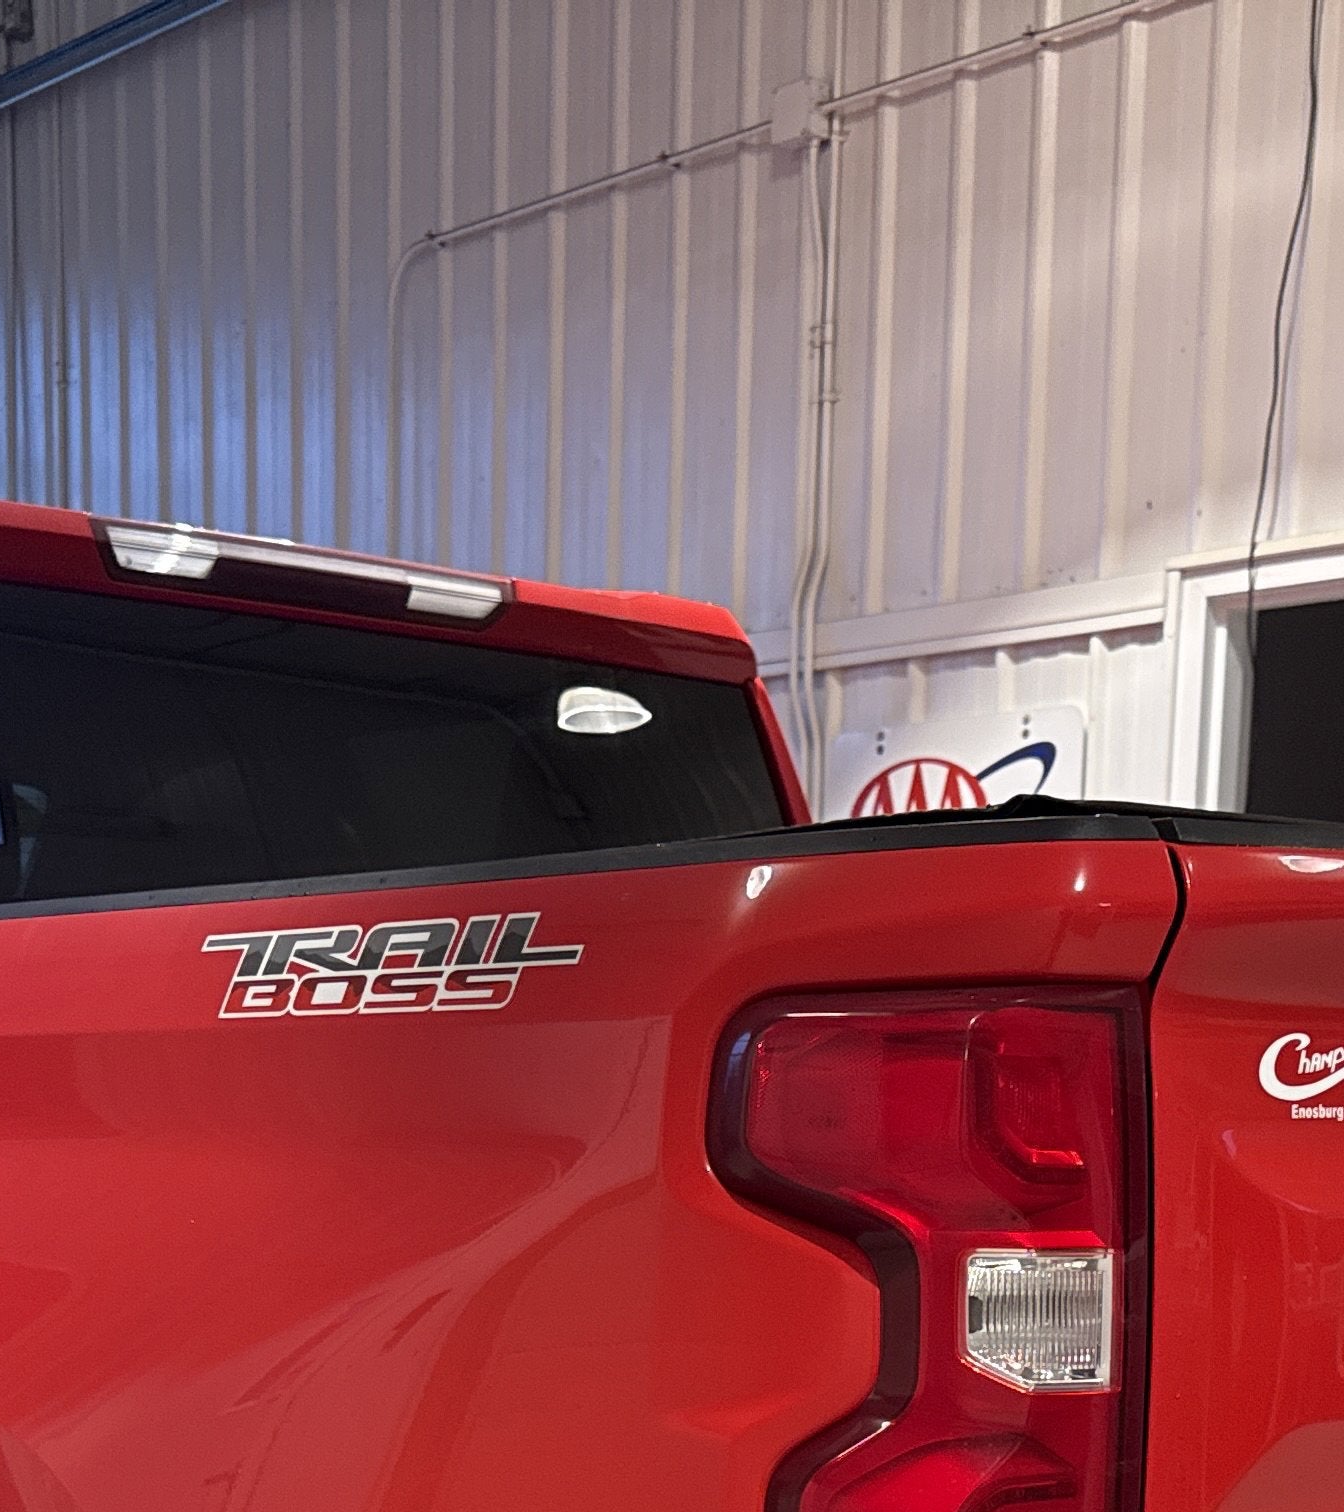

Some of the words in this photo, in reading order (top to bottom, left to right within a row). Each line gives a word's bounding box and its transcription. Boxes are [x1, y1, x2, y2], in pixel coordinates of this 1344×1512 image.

[200, 911, 586, 977] TRAIL
[218, 966, 523, 1019] BOSS
[1291, 1103, 1344, 1121] Enosburg
